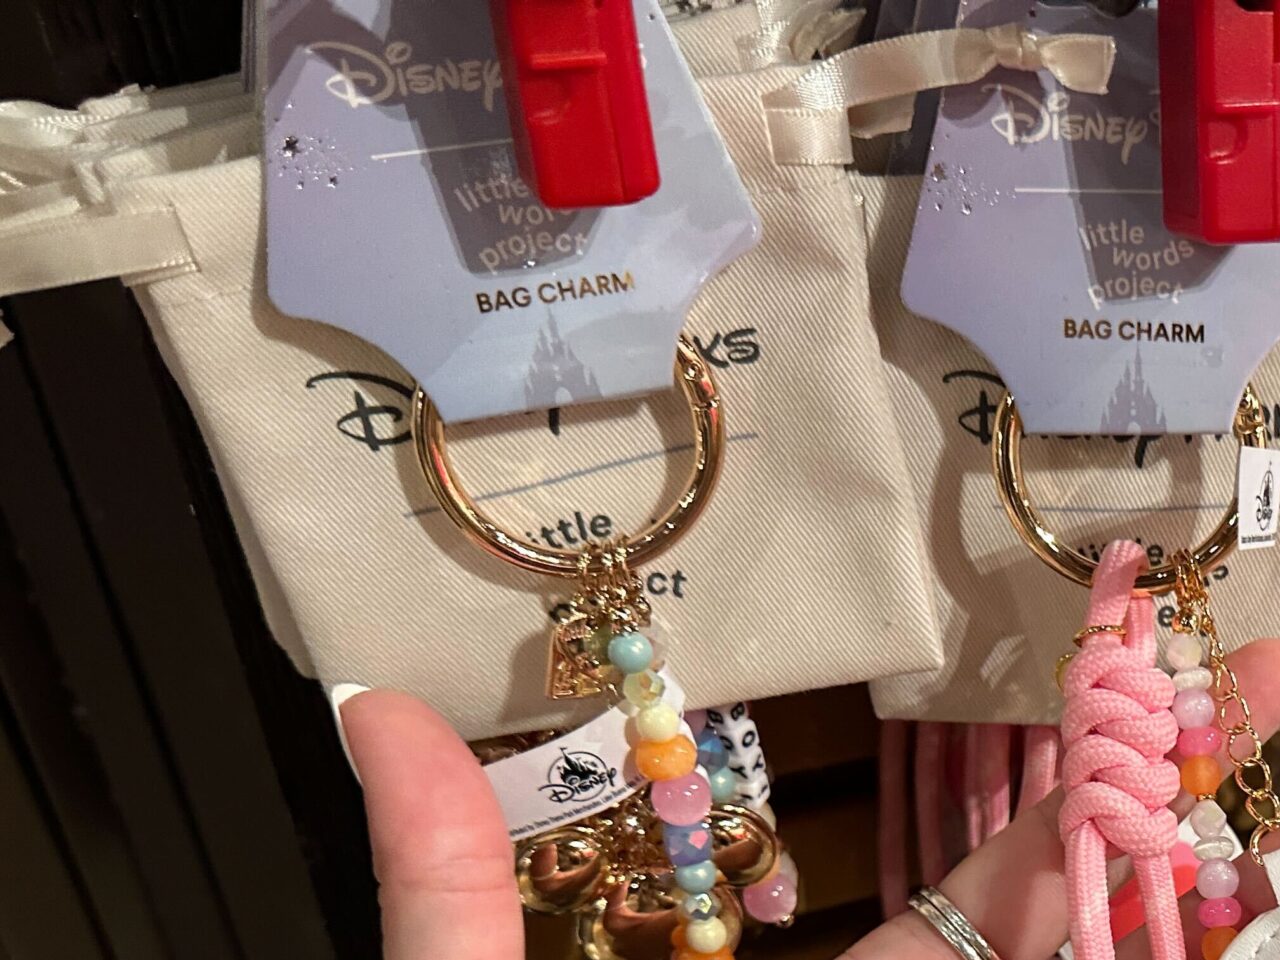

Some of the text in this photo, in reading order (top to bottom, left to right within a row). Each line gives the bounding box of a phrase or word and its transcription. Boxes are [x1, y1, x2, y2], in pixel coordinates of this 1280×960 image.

[454, 171, 528, 213] little
[479, 225, 589, 276] project
[1079, 218, 1145, 251] little
[1112, 239, 1195, 271] words
[476, 271, 635, 314] BAG CHARM
[1088, 271, 1185, 311] project
[1063, 318, 1206, 344] BAG CHARM
